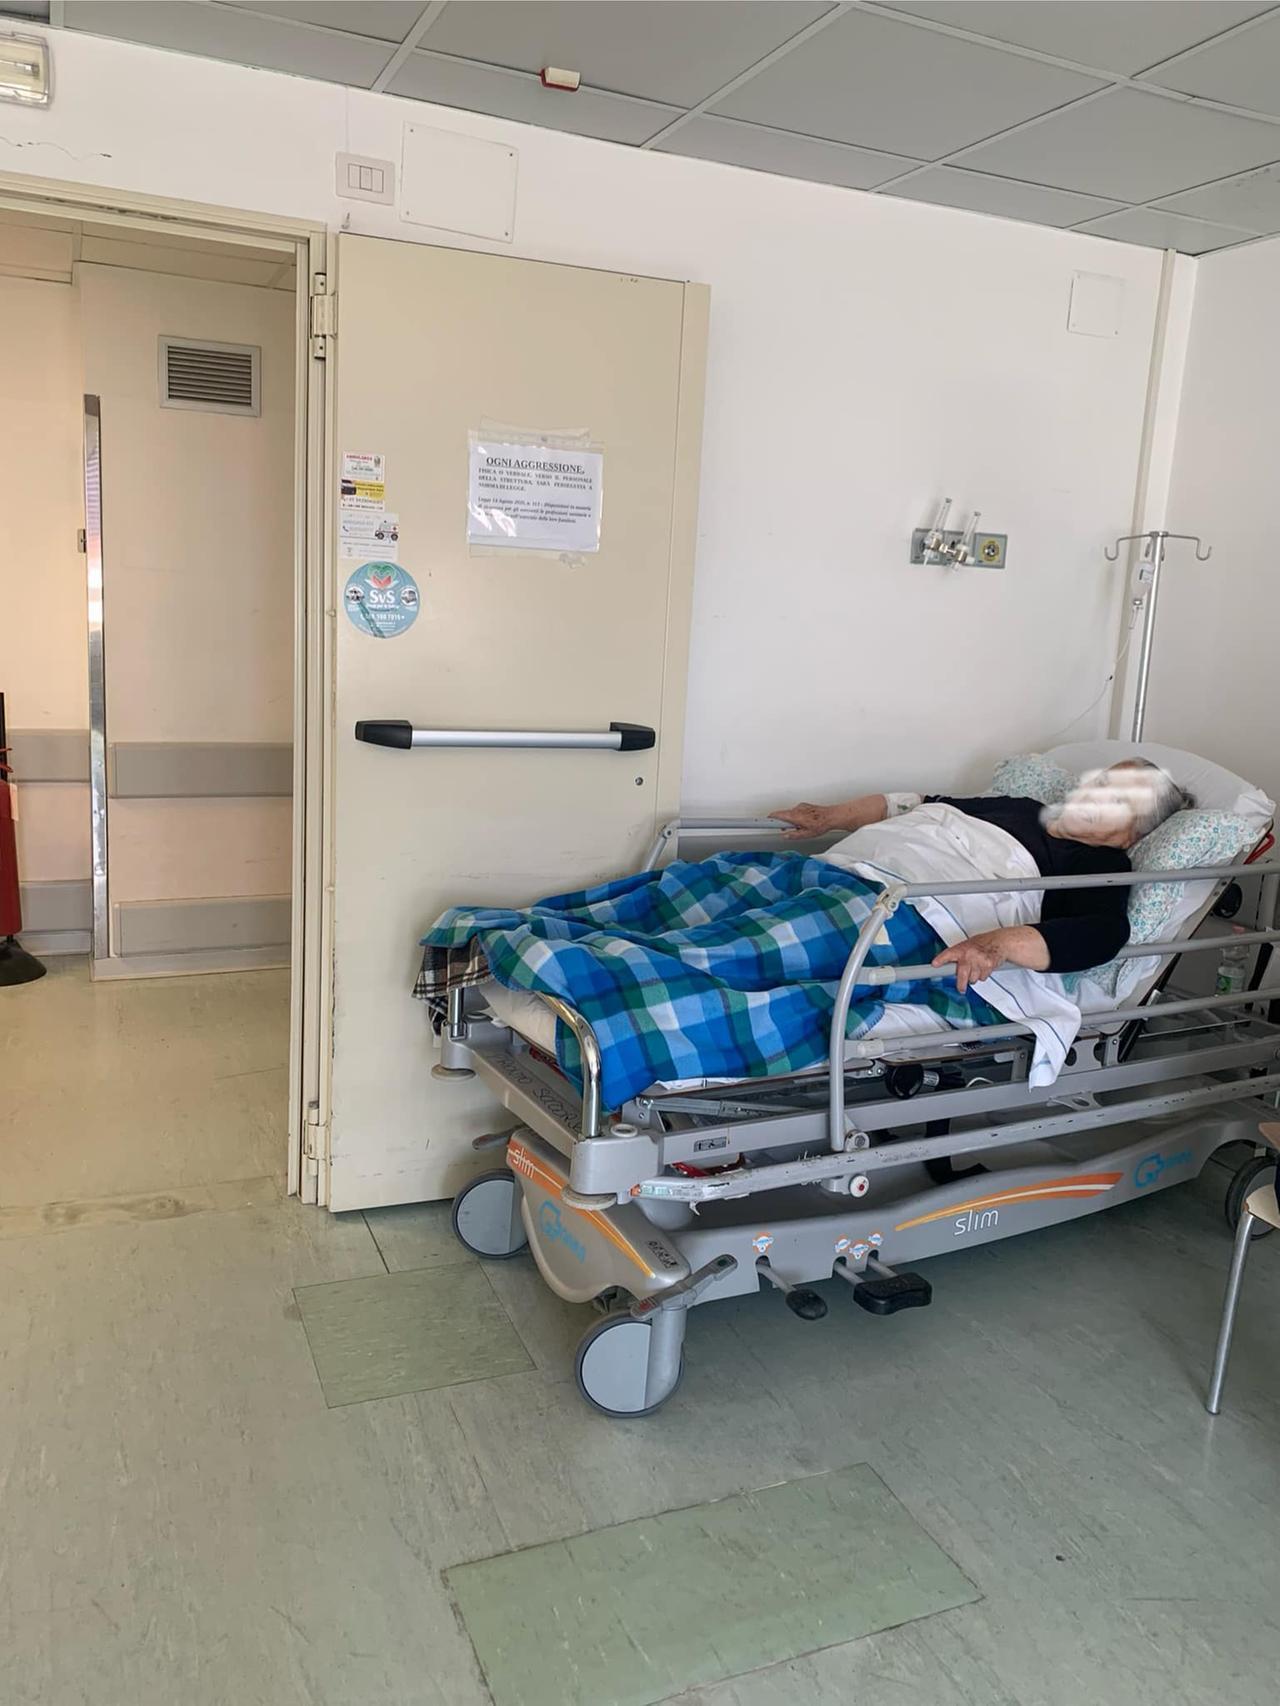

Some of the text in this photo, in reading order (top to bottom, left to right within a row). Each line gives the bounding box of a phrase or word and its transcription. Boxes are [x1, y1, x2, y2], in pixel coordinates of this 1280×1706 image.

[486, 457, 585, 475] OGNI AGGRESSIONE,
[562, 475, 592, 484] PERSONALE
[369, 590, 396, 604] SvS
[512, 1147, 535, 1179] slim
[954, 1209, 999, 1236] slim
